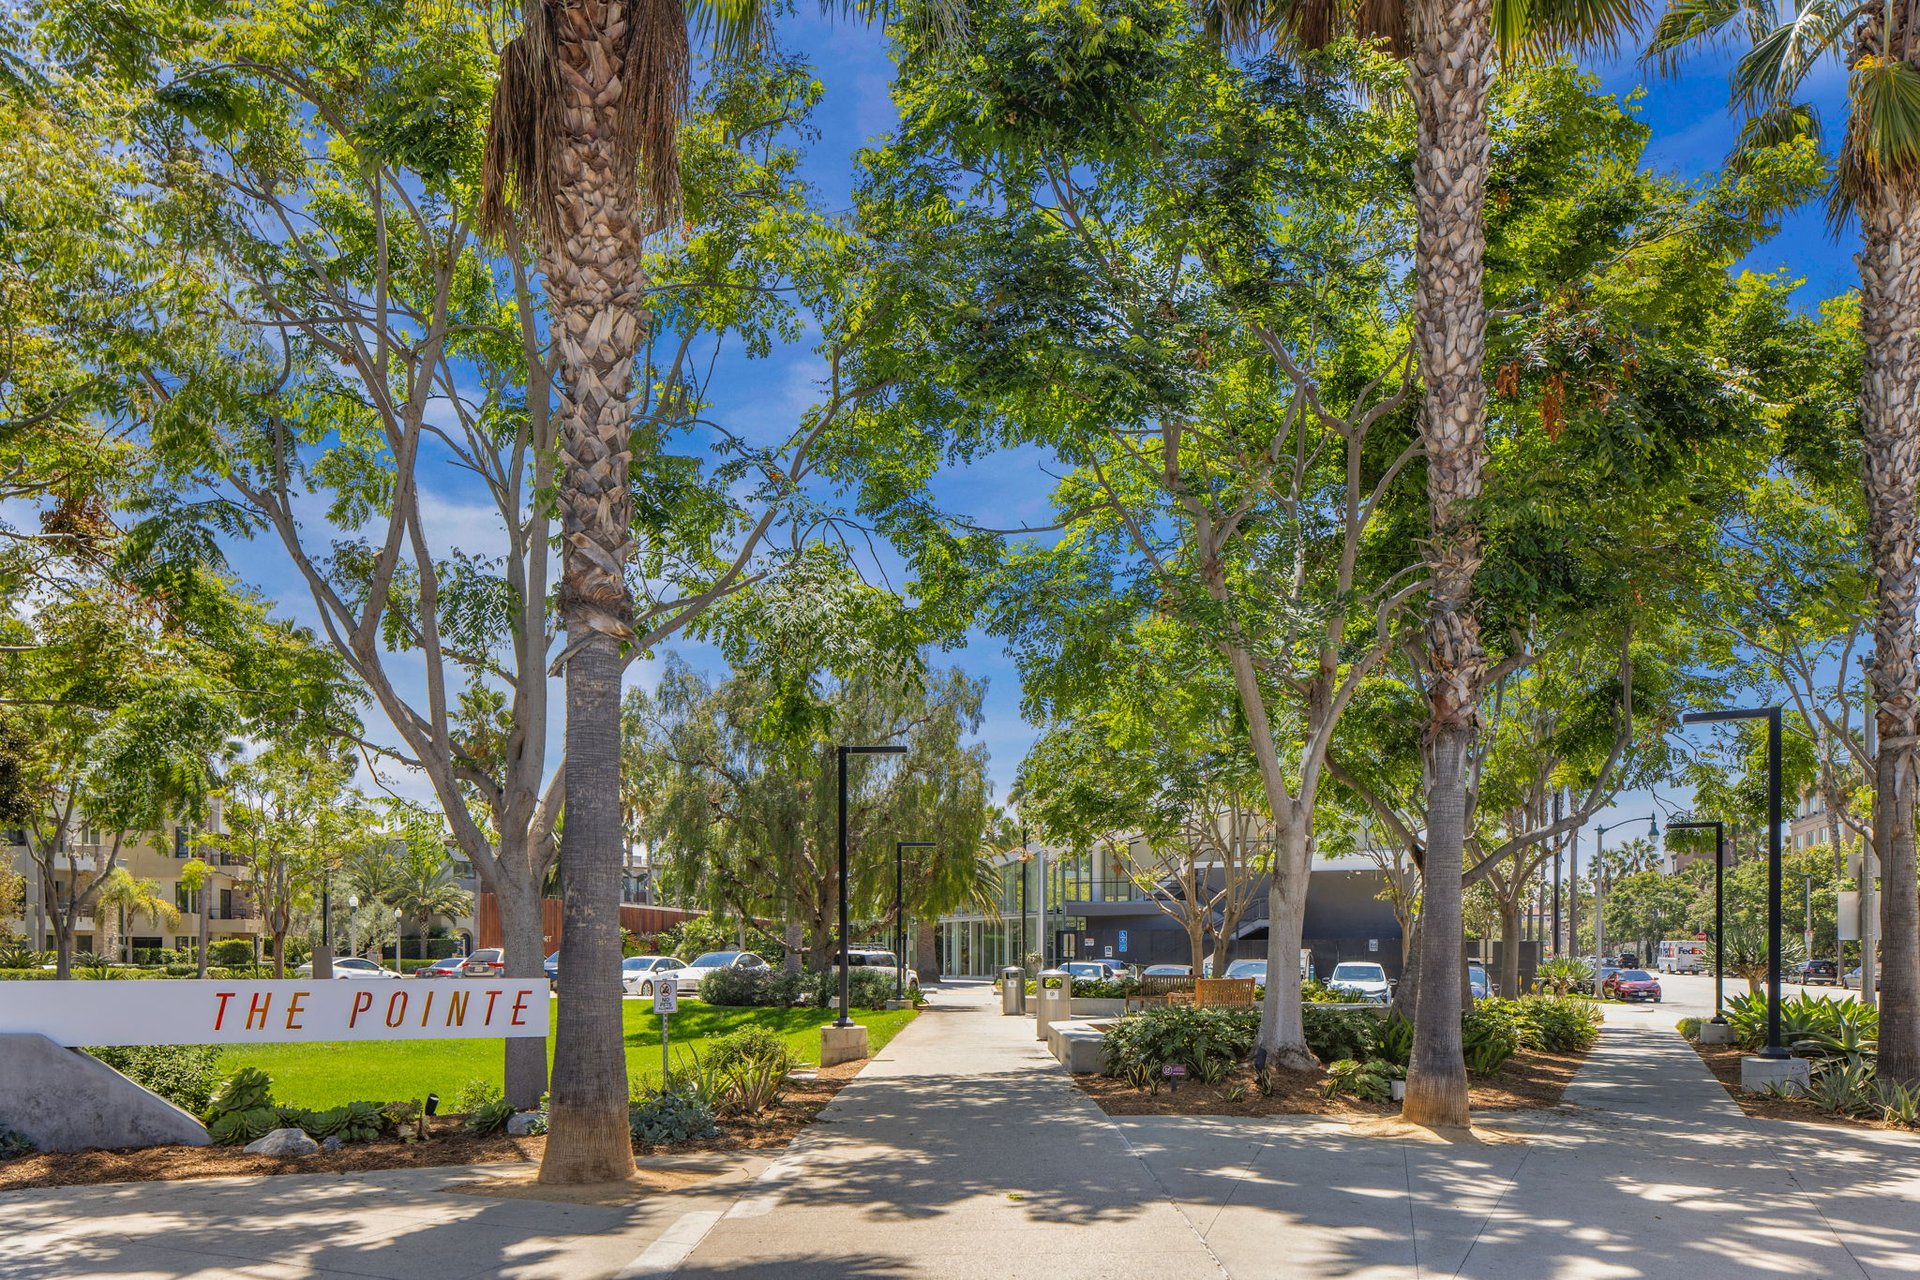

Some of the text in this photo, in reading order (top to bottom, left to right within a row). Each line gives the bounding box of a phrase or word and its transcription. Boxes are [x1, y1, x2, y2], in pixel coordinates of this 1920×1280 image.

[1678, 947, 1705, 955] FedEx
[214, 990, 533, 1031] THE POINTE
